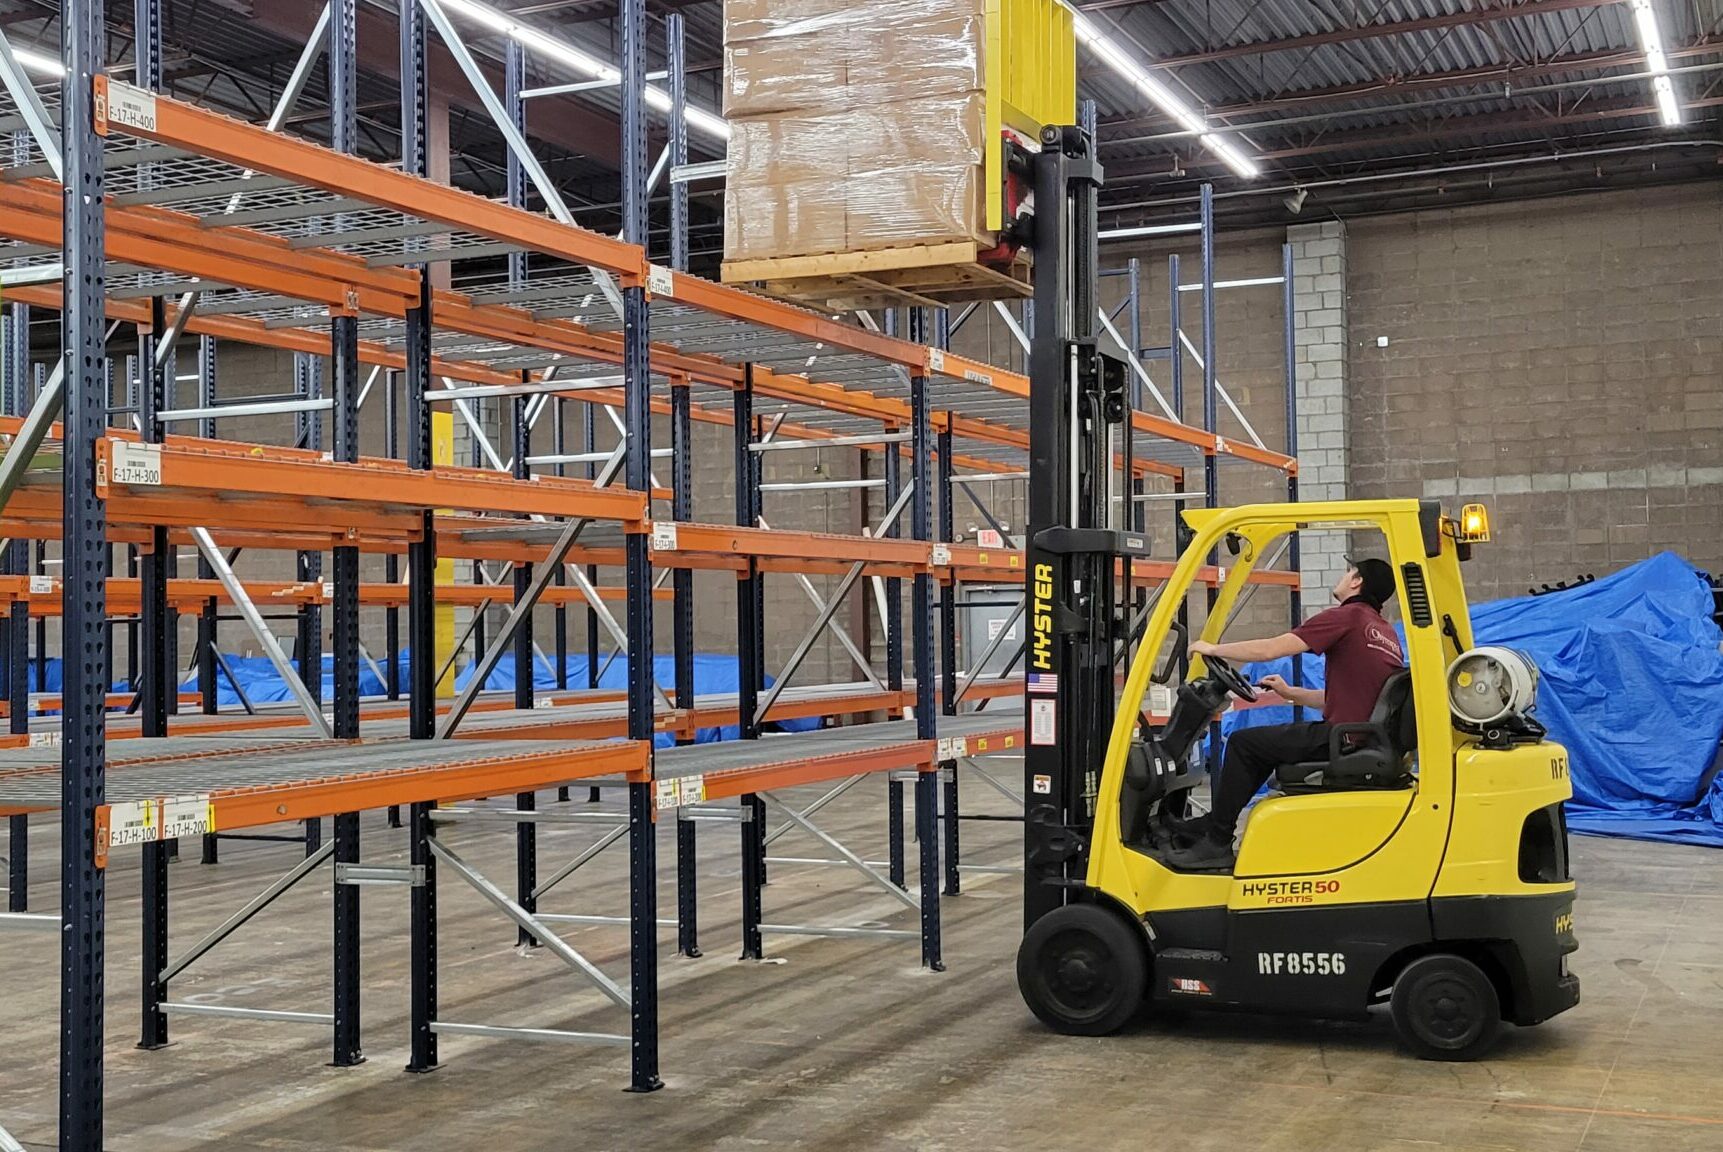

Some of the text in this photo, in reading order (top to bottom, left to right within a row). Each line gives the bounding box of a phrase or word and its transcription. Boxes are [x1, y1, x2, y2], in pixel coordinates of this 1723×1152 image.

[109, 107, 155, 131] F-17-H-400
[113, 467, 159, 483] F-17-H-300
[1033, 563, 1053, 670] HYSTER
[1550, 757, 1569, 780] RF
[111, 826, 157, 844] F-17-H-100
[164, 820, 208, 838] F-17-H-200
[1242, 880, 1340, 897] HYSTER 50
[1267, 895, 1313, 904] FORTIS
[1257, 952, 1346, 975] RF8556
